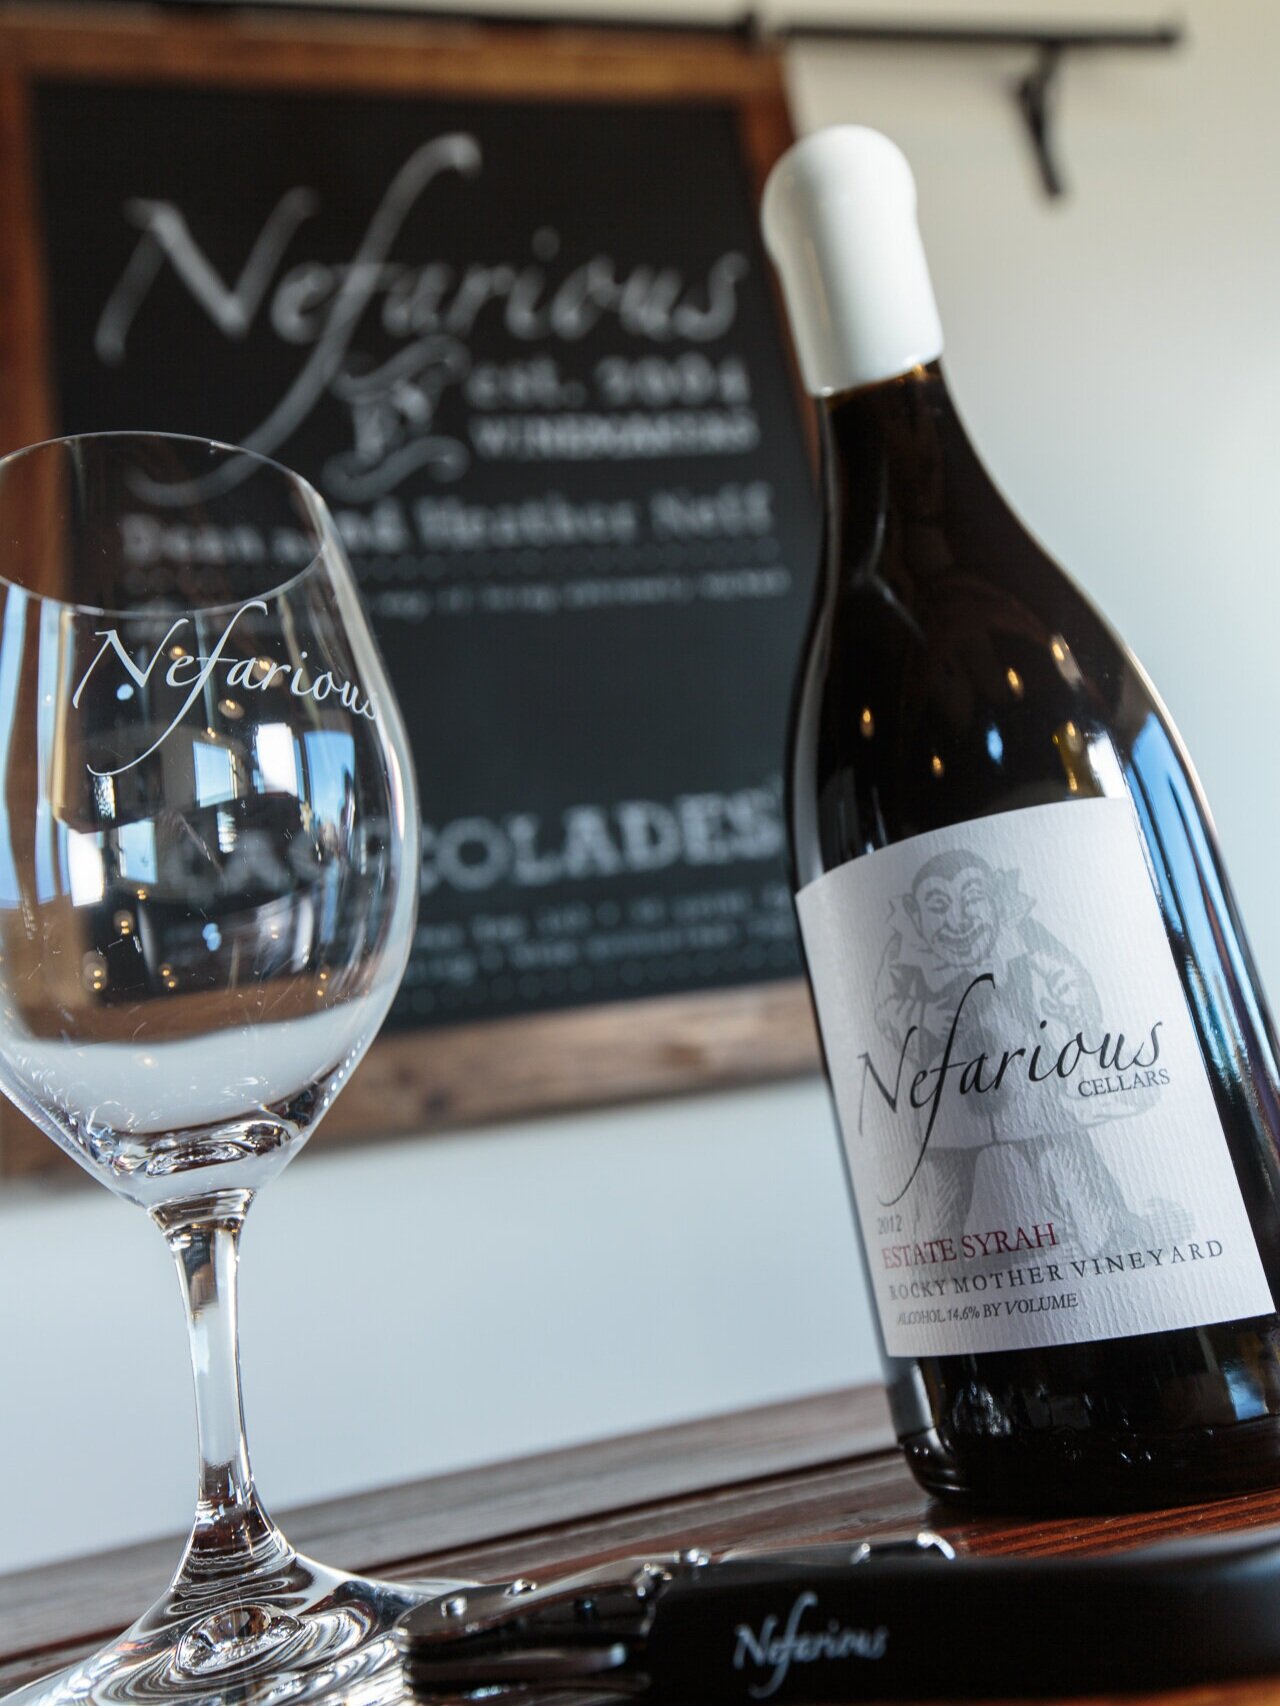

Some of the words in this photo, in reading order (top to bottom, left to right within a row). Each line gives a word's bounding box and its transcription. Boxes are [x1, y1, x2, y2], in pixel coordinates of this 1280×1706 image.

[95, 130, 747, 502] Nefarious
[72, 600, 378, 777] Nefarious
[857, 973, 1164, 1207] Nefarious
[1077, 1068, 1171, 1098] CELLARS
[877, 1214, 903, 1235] 2012
[882, 1238, 957, 1270] ESTATE
[960, 1222, 1061, 1260] SYRAH
[889, 1279, 947, 1301] ROCKY
[949, 1264, 1065, 1295] MOTHER
[1071, 1239, 1223, 1279] VINEYARD
[896, 1309, 947, 1326] ALCOHOL
[948, 1305, 981, 1321] 14.6%
[983, 1303, 1003, 1319] BY
[1004, 1292, 1079, 1316] VOLUME
